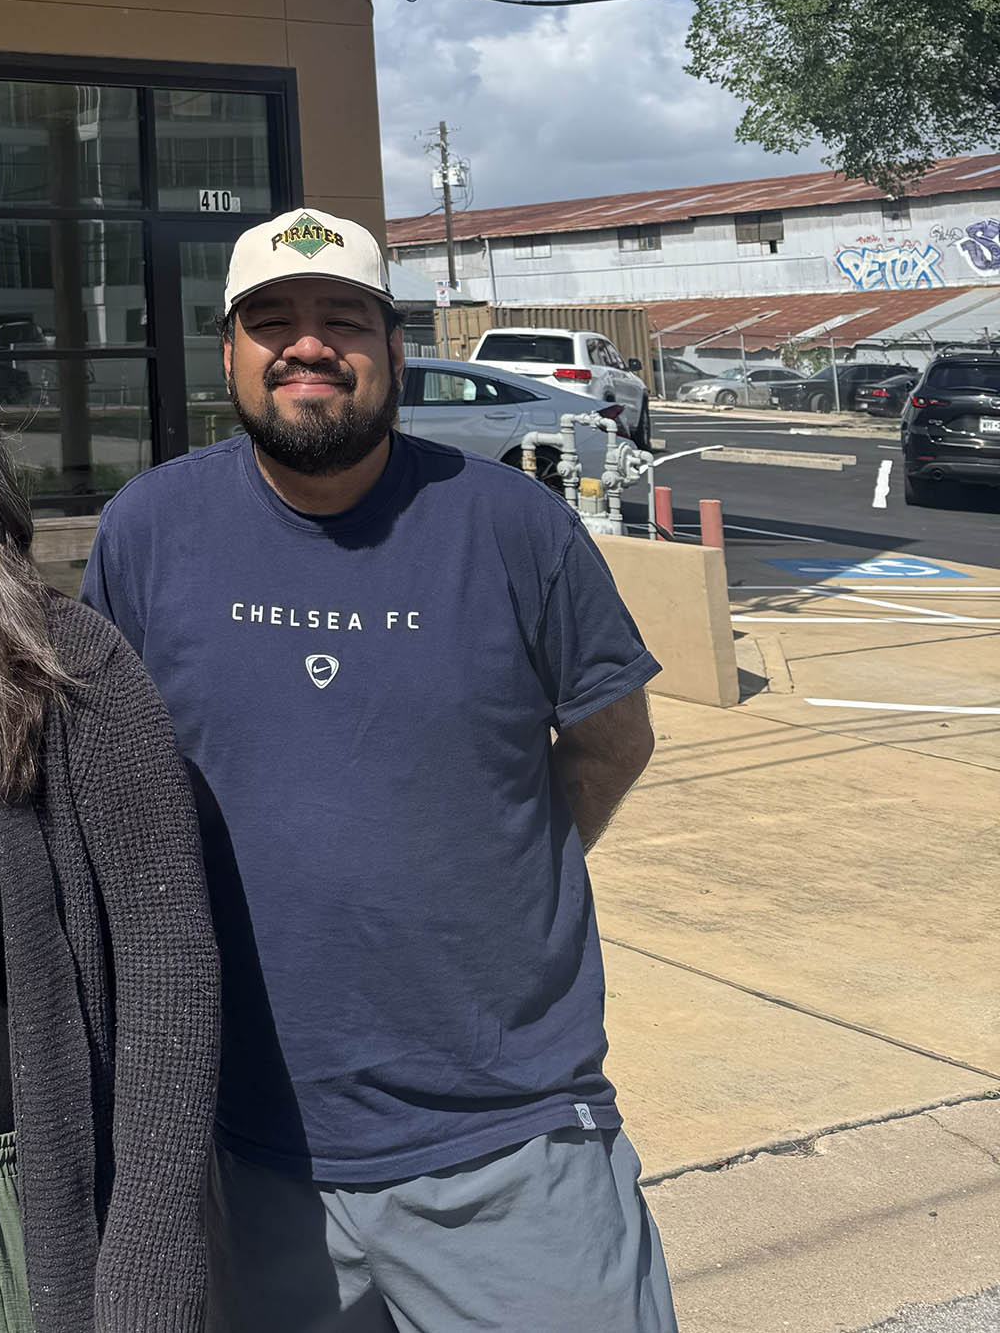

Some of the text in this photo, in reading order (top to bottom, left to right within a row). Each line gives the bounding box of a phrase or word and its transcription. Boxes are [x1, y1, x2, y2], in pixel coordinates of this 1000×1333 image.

[201, 191, 231, 211] 410
[271, 224, 345, 252] PIRATES
[837, 244, 944, 290] DETOX
[231, 602, 420, 631] CHELSEA FC
